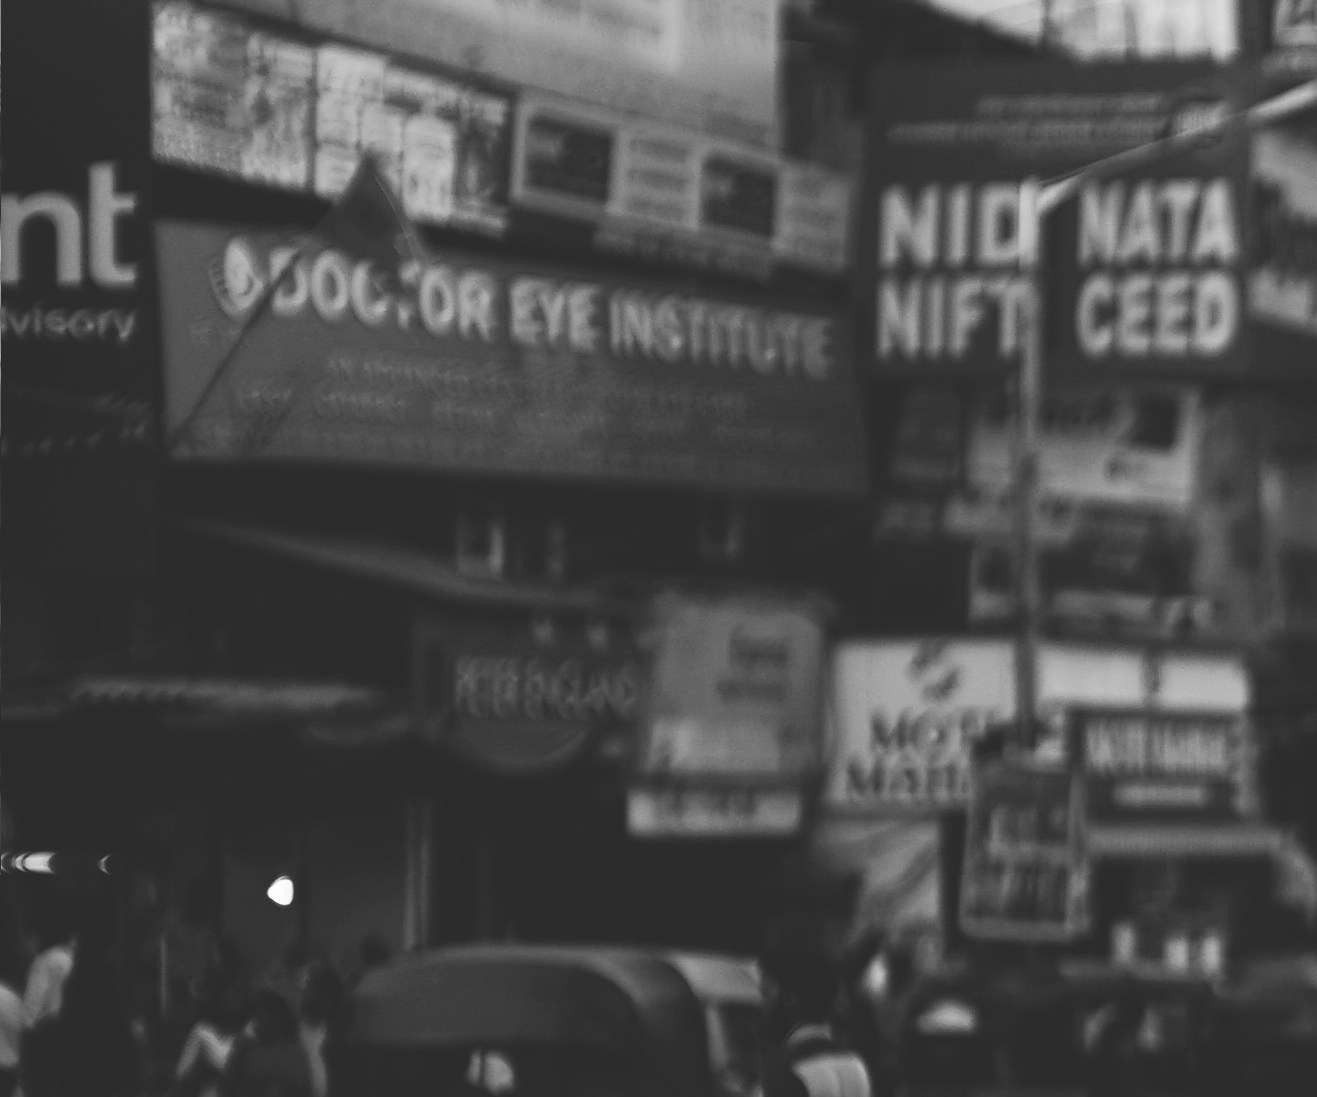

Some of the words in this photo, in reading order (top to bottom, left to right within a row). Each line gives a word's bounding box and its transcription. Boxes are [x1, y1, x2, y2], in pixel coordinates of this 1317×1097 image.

[0, 162, 138, 289] nt
[879, 182, 1036, 268] NID
[1077, 179, 1238, 268] NATA
[0, 303, 136, 346] visory
[509, 276, 601, 354] EYE
[608, 287, 832, 381] INSTITUTE
[877, 274, 1034, 361] NIFT
[1075, 270, 1236, 357] CEED
